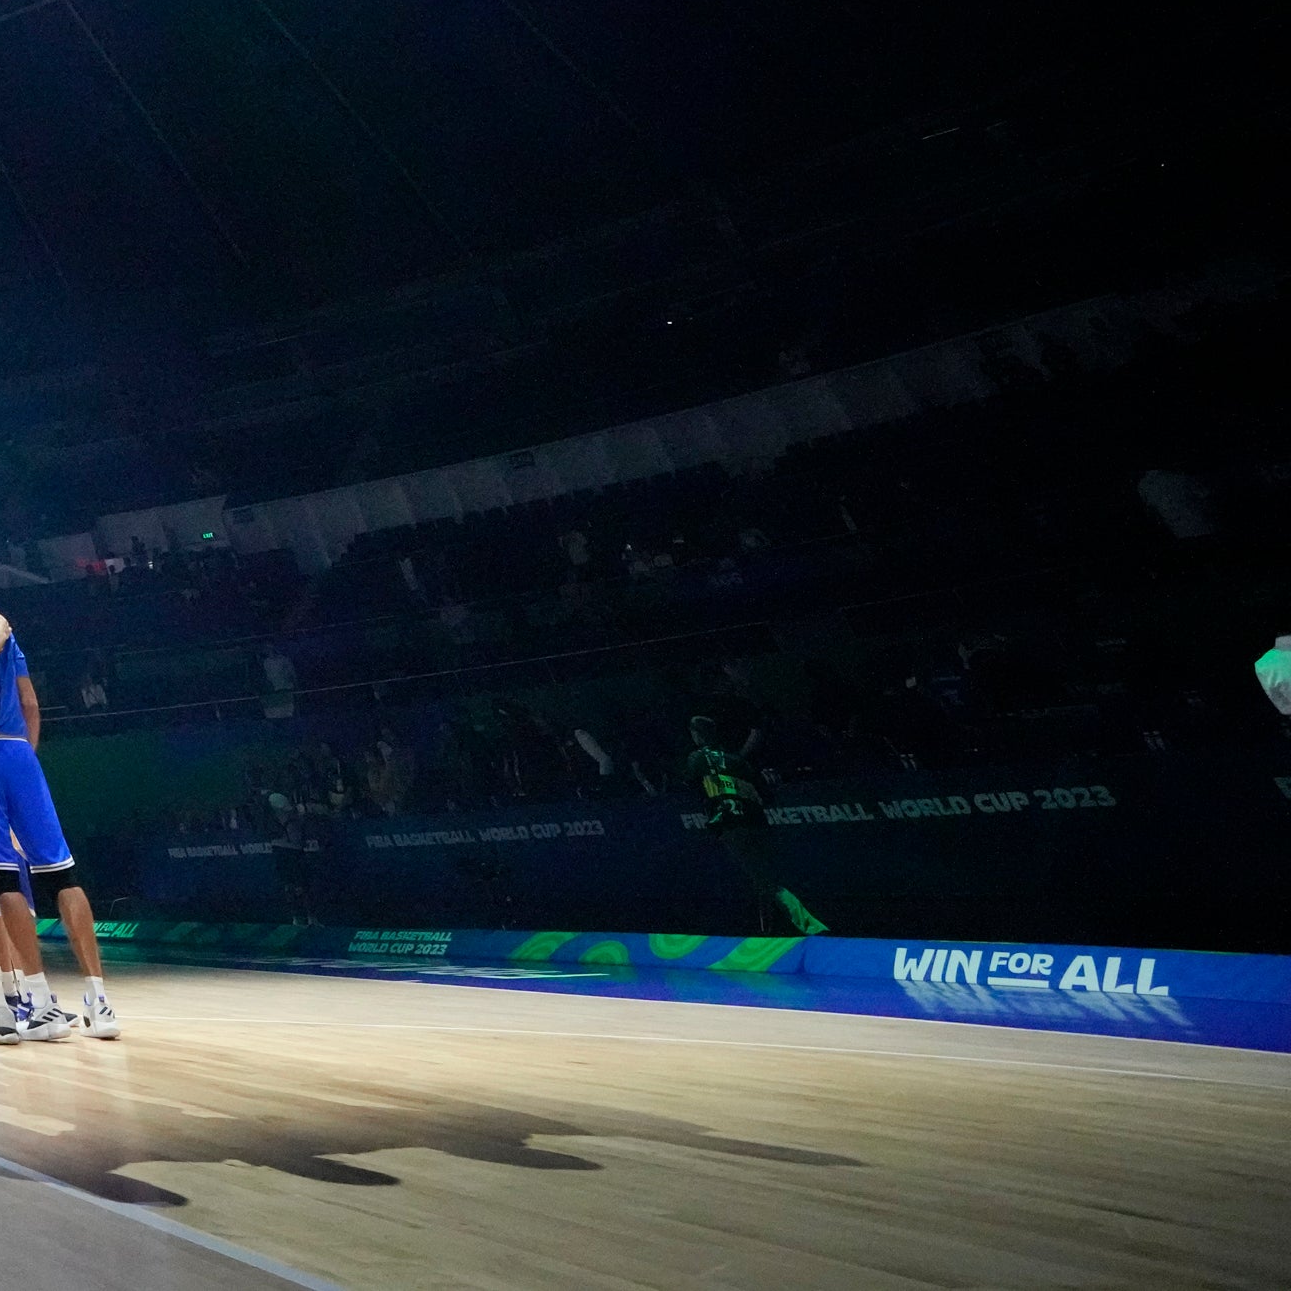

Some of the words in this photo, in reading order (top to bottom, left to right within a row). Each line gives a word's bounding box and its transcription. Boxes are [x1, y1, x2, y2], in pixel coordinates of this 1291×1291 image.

[878, 793, 972, 822] WORLD
[974, 790, 1030, 813] CUP
[1033, 785, 1118, 810] 2023
[394, 828, 476, 846] BASKETBALL
[480, 824, 530, 842] WORLD
[531, 821, 562, 838] CUP
[564, 819, 606, 837] 2023
[111, 922, 139, 938] ALL
[354, 930, 379, 940] FIBA
[380, 931, 452, 942] BASKETBALL
[348, 942, 389, 953] WORLD
[390, 943, 414, 954] CUP
[415, 943, 448, 955] 2023
[893, 947, 983, 984] WIN
[989, 951, 1054, 976] FOR
[1059, 955, 1169, 997] ALL
